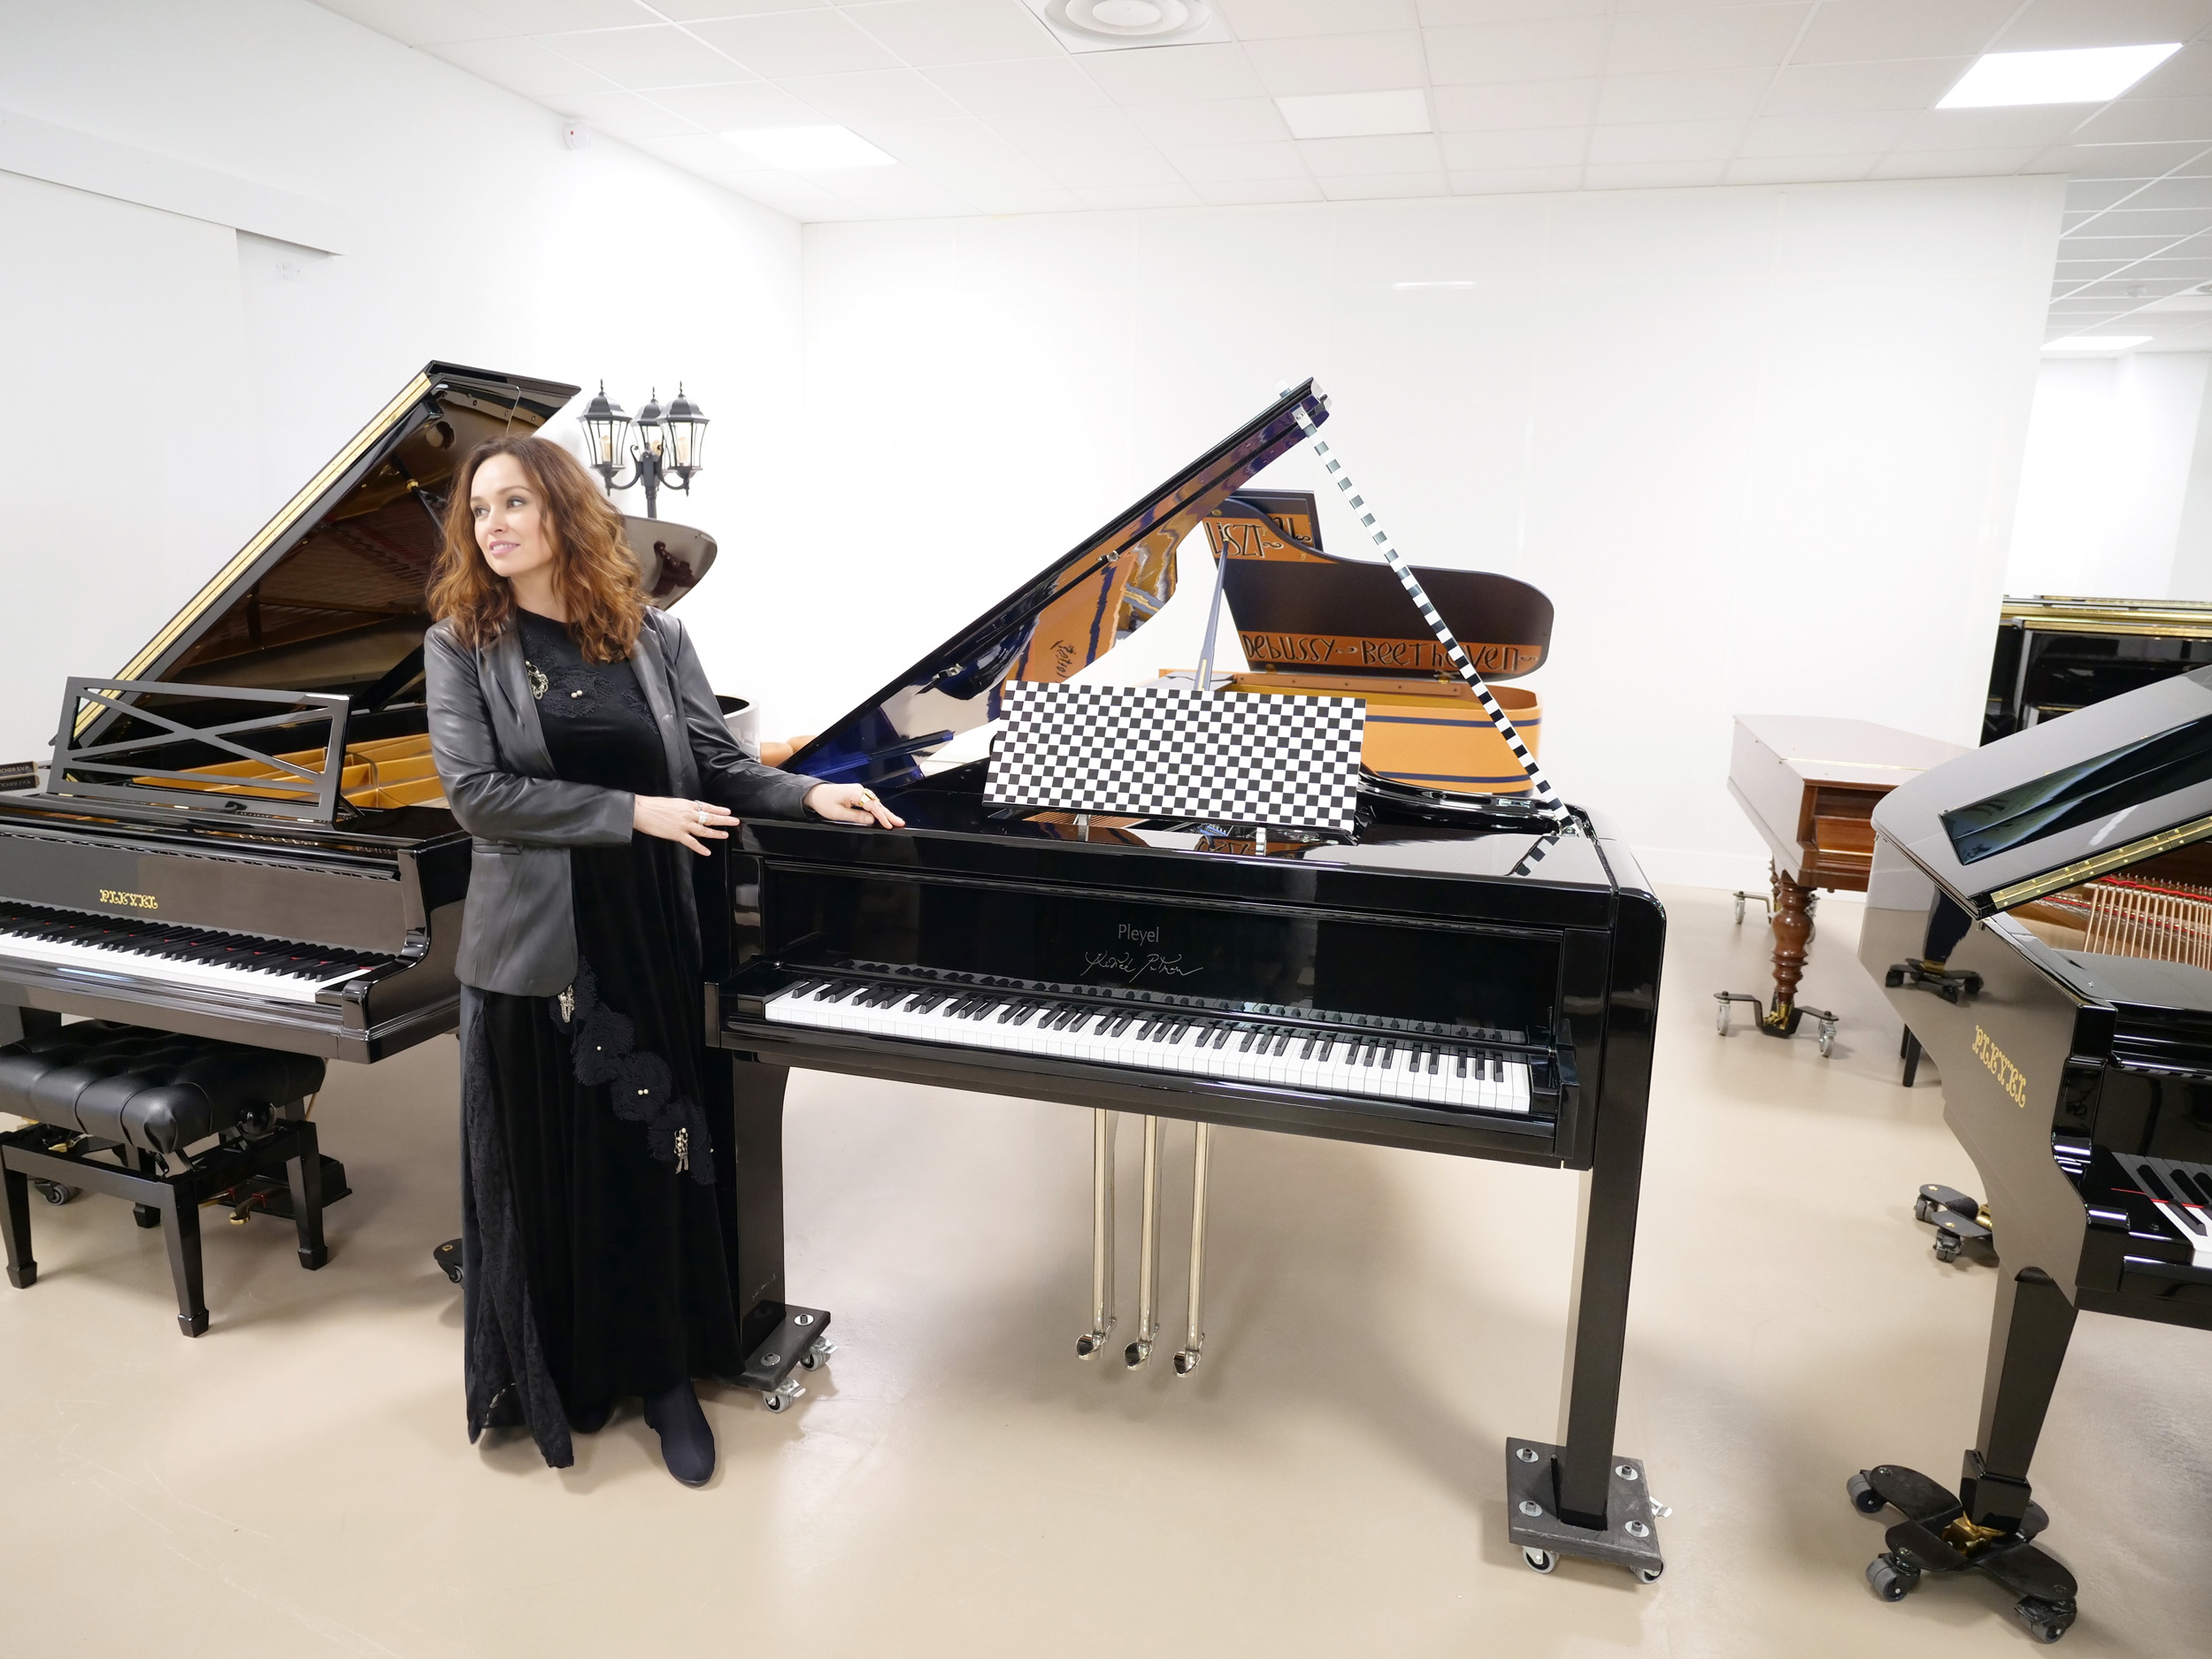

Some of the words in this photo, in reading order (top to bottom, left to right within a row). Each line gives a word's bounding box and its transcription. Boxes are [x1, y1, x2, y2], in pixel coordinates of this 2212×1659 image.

[99, 889, 158, 910] PLEYEL
[1118, 923, 1159, 947] Pleyel
[1971, 1025, 2027, 1108] PLEYEL
